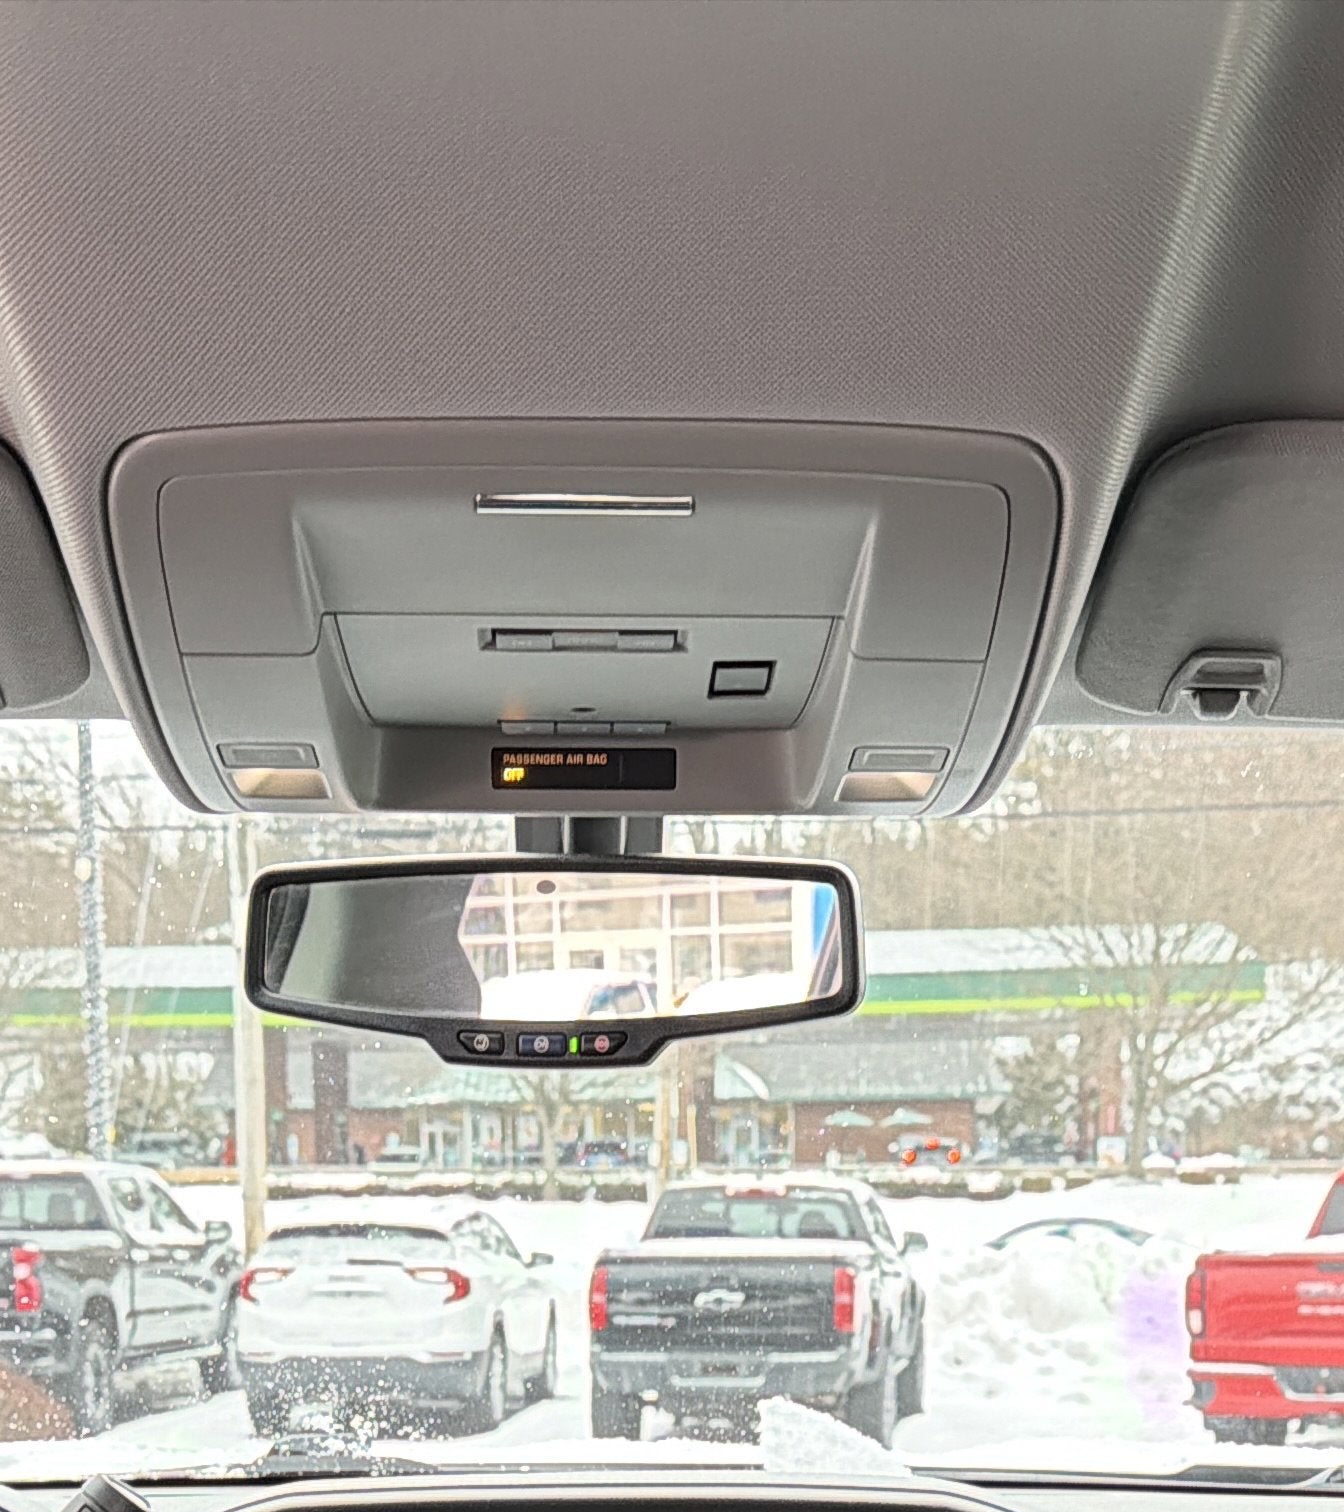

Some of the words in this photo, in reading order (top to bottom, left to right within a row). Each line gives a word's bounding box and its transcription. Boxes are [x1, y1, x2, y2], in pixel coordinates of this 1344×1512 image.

[502, 753, 564, 766] PASSENGER
[566, 753, 584, 766] AIR
[586, 753, 608, 766] BAG
[503, 767, 525, 782] OFF
